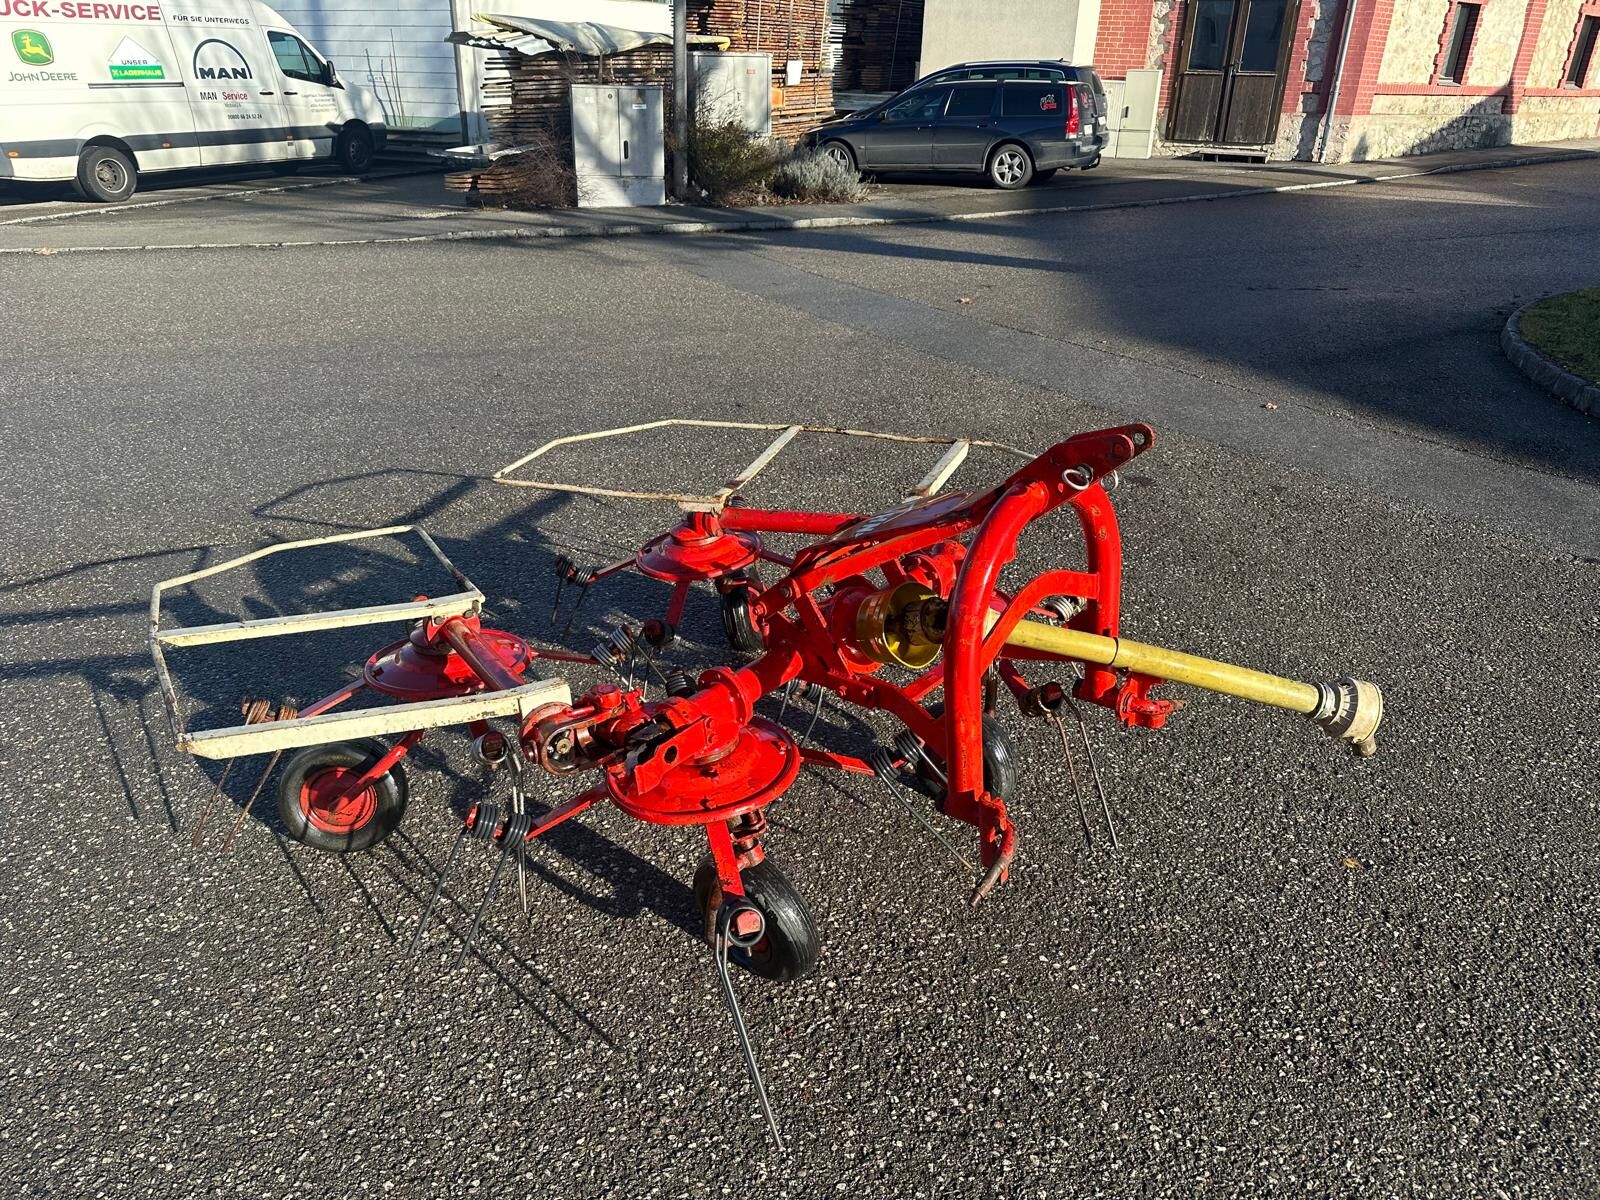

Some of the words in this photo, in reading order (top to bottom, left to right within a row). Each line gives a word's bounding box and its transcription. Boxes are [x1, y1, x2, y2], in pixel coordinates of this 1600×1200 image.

[173, 15, 188, 23] FÜR
[190, 15, 202, 23] SIE
[205, 16, 250, 25] UNTERWEGS
[8, 71, 40, 82] JOHN
[41, 72, 78, 82] DEERE
[198, 67, 247, 79] MAN
[200, 91, 217, 101] MAN
[222, 91, 248, 101] Service
